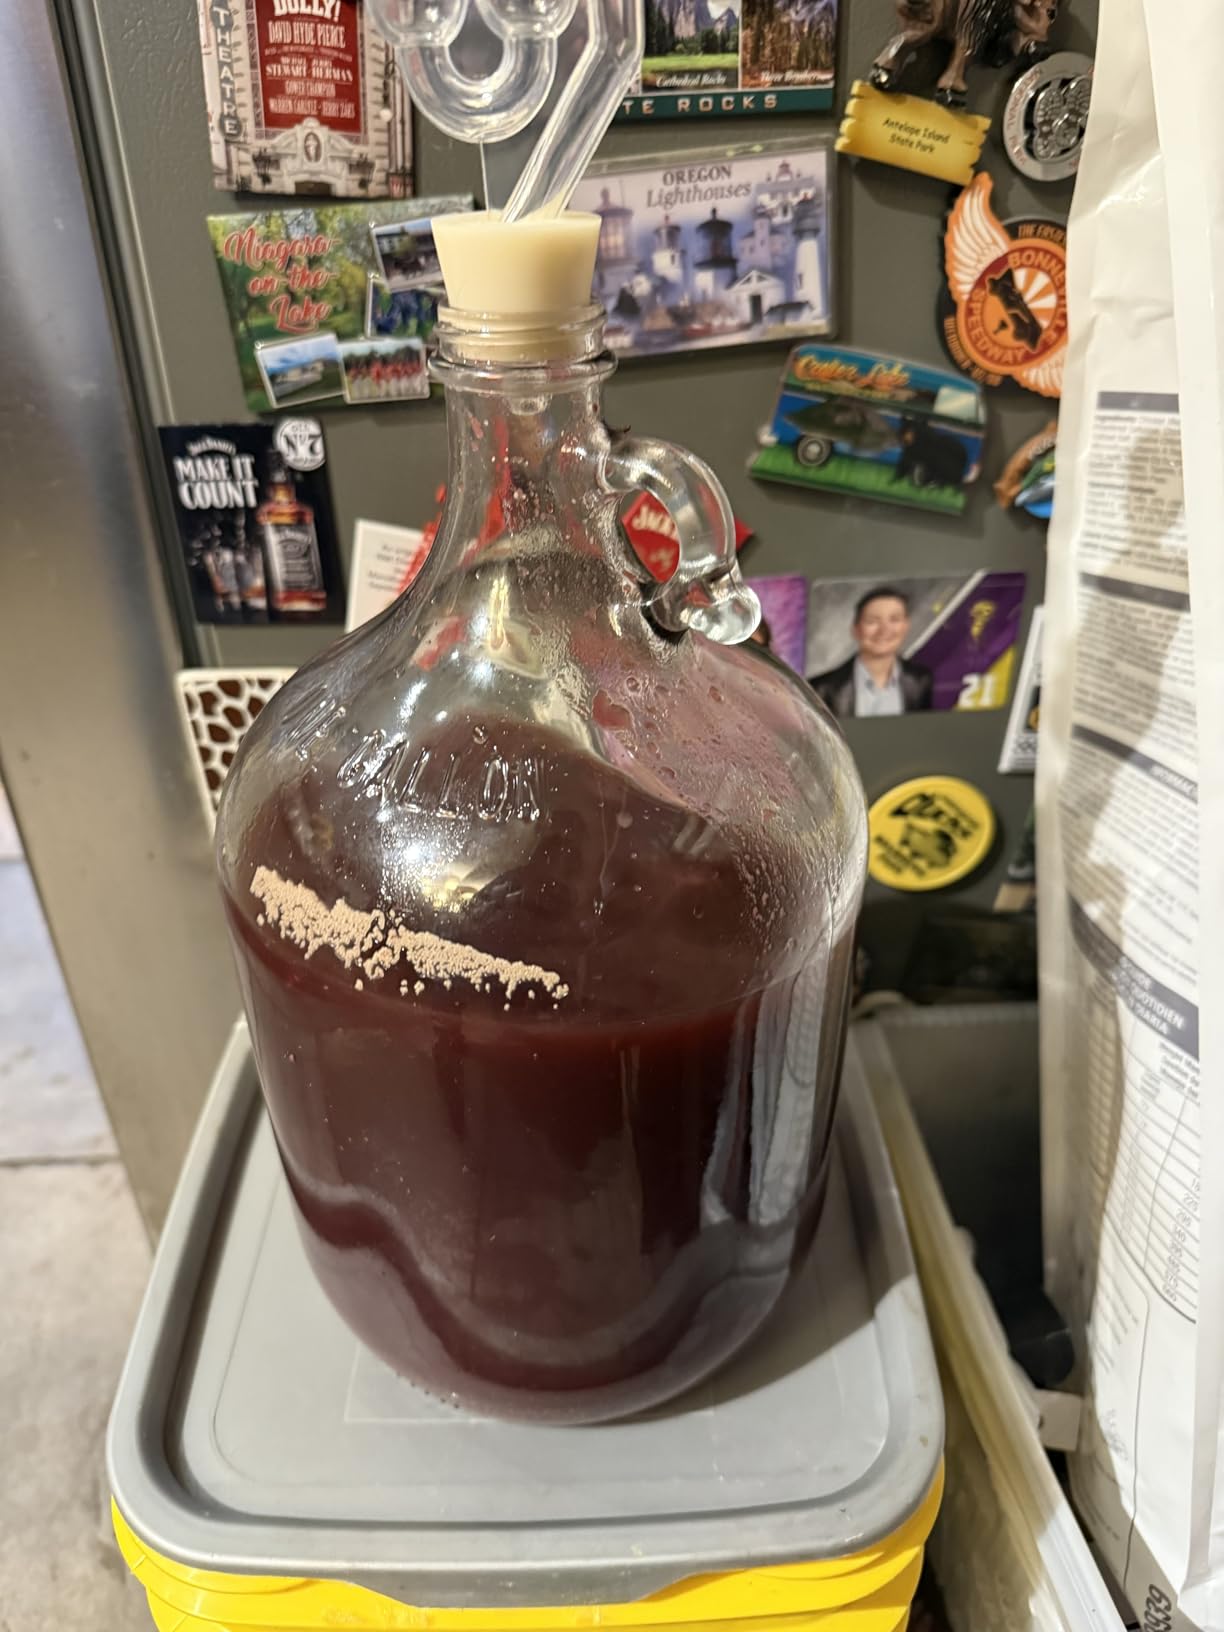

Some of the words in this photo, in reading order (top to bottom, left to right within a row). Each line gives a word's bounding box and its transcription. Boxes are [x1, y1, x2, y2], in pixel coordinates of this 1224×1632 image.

[268, 20, 292, 44] DAVID
[293, 21, 316, 45] HYDE
[316, 23, 346, 49] PIERCE
[213, 6, 241, 134] THEATRE
[677, 93, 778, 113] ROCKS
[883, 118, 920, 136] Antelope
[922, 127, 951, 145] Island
[889, 133, 914, 148] State
[915, 140, 935, 153] Park
[663, 164, 733, 187] OREGON
[646, 182, 752, 211] Lighthouses
[270, 294, 332, 335] Lake
[968, 287, 1028, 365] SPEEDWAY
[795, 354, 858, 381] Crater
[857, 360, 911, 389] Lake
[173, 456, 232, 482] MAKE
[231, 454, 255, 482] IT
[178, 479, 259, 510] COUNT
[958, 673, 997, 707] 21
